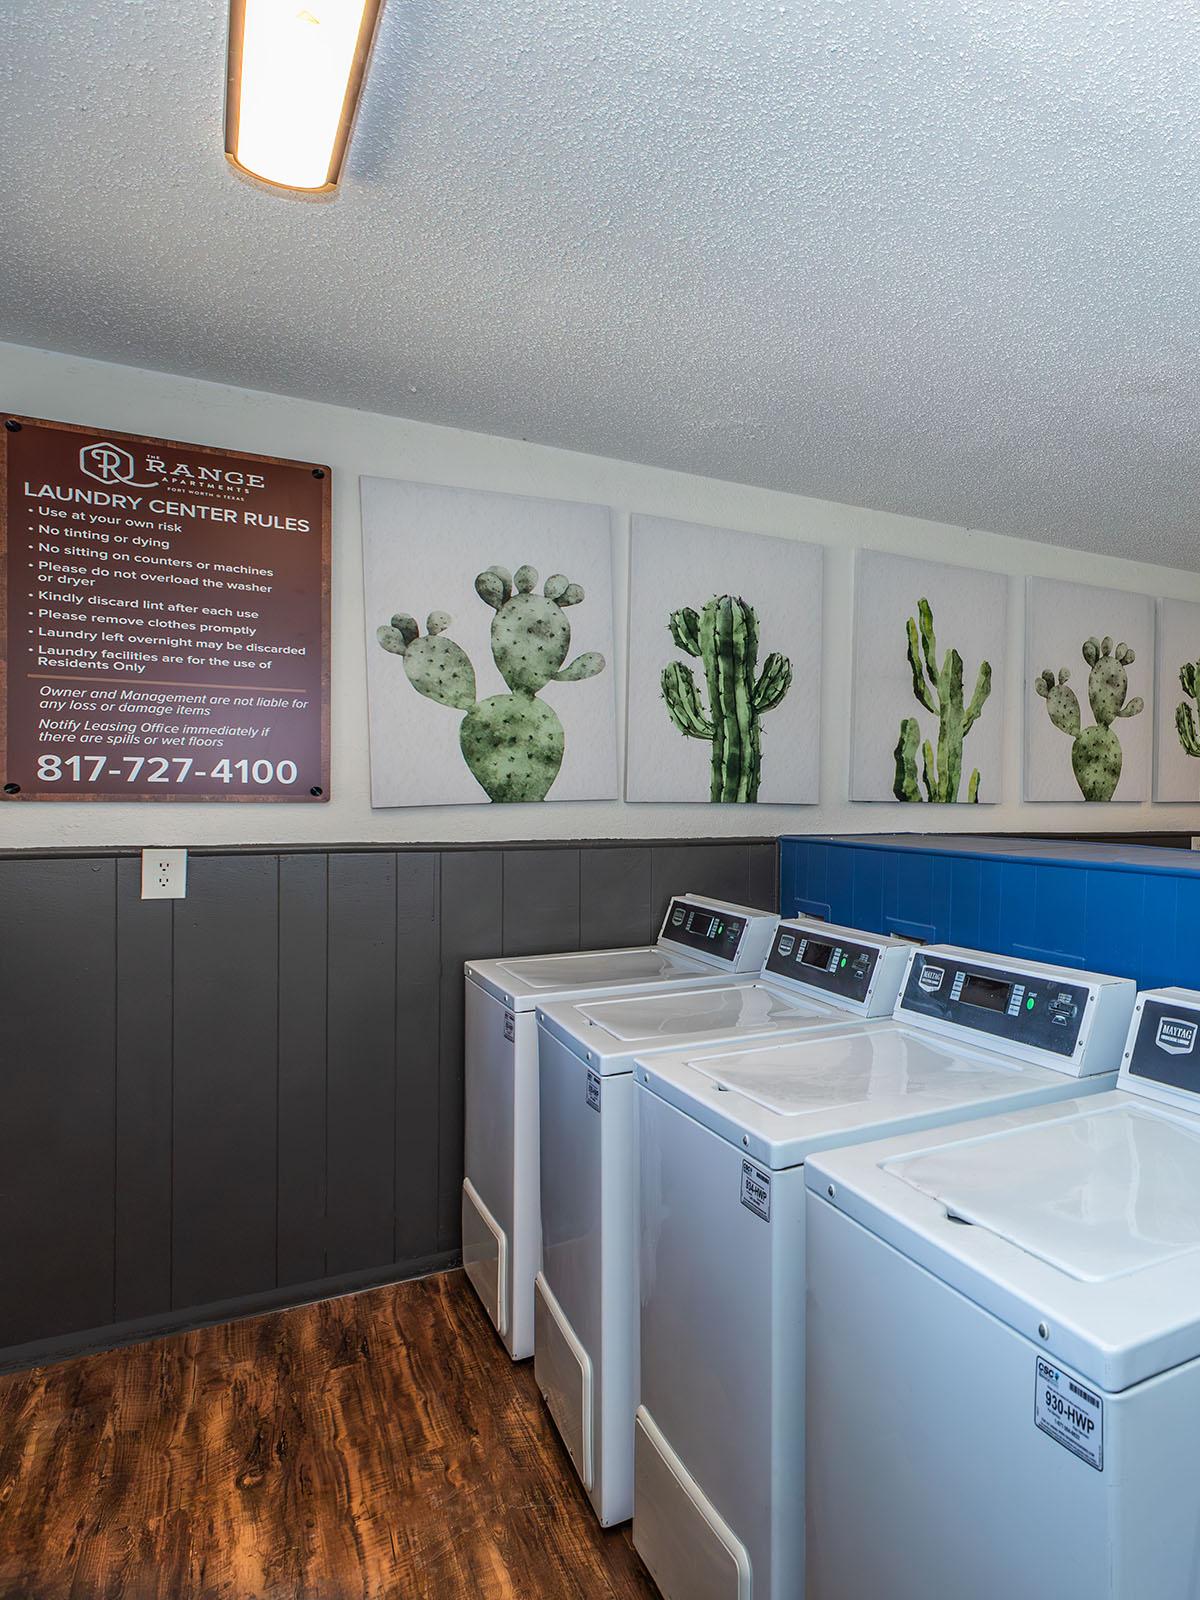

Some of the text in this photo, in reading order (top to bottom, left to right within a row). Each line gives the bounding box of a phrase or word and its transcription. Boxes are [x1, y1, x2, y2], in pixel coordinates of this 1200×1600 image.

[146, 459, 265, 488] RANGE
[162, 477, 250, 494] APARTMENTS
[24, 481, 310, 533] LAUNDRY CENTER RULES
[39, 506, 182, 533] Use at your own risk
[39, 524, 170, 550] No tinting or dying
[39, 542, 274, 577] No sitting on counters or machines
[38, 574, 96, 587] or dryer
[39, 561, 273, 593] Please do not overload the washer
[39, 591, 259, 619] Kindly discard lint after each use
[39, 609, 257, 637] Please remove clothes promptly
[39, 627, 306, 655] Laundry left overnight may be discarded
[38, 656, 146, 673] Residents Only
[39, 645, 273, 669] Laundry facilities are for the use of
[39, 700, 212, 716] any loss or damage items
[40, 686, 309, 709] Owner and Management are not liable for
[38, 719, 271, 739] Notify Leasing Office immediately if
[38, 732, 224, 747] there are spills or wet floors
[37, 754, 298, 784] 817-727-4100
[1162, 1024, 1192, 1040] MAYTAG
[746, 1179, 767, 1200] 934-HWP
[1039, 1363, 1054, 1378] CSC
[1045, 1391, 1095, 1434] 930-HWP
